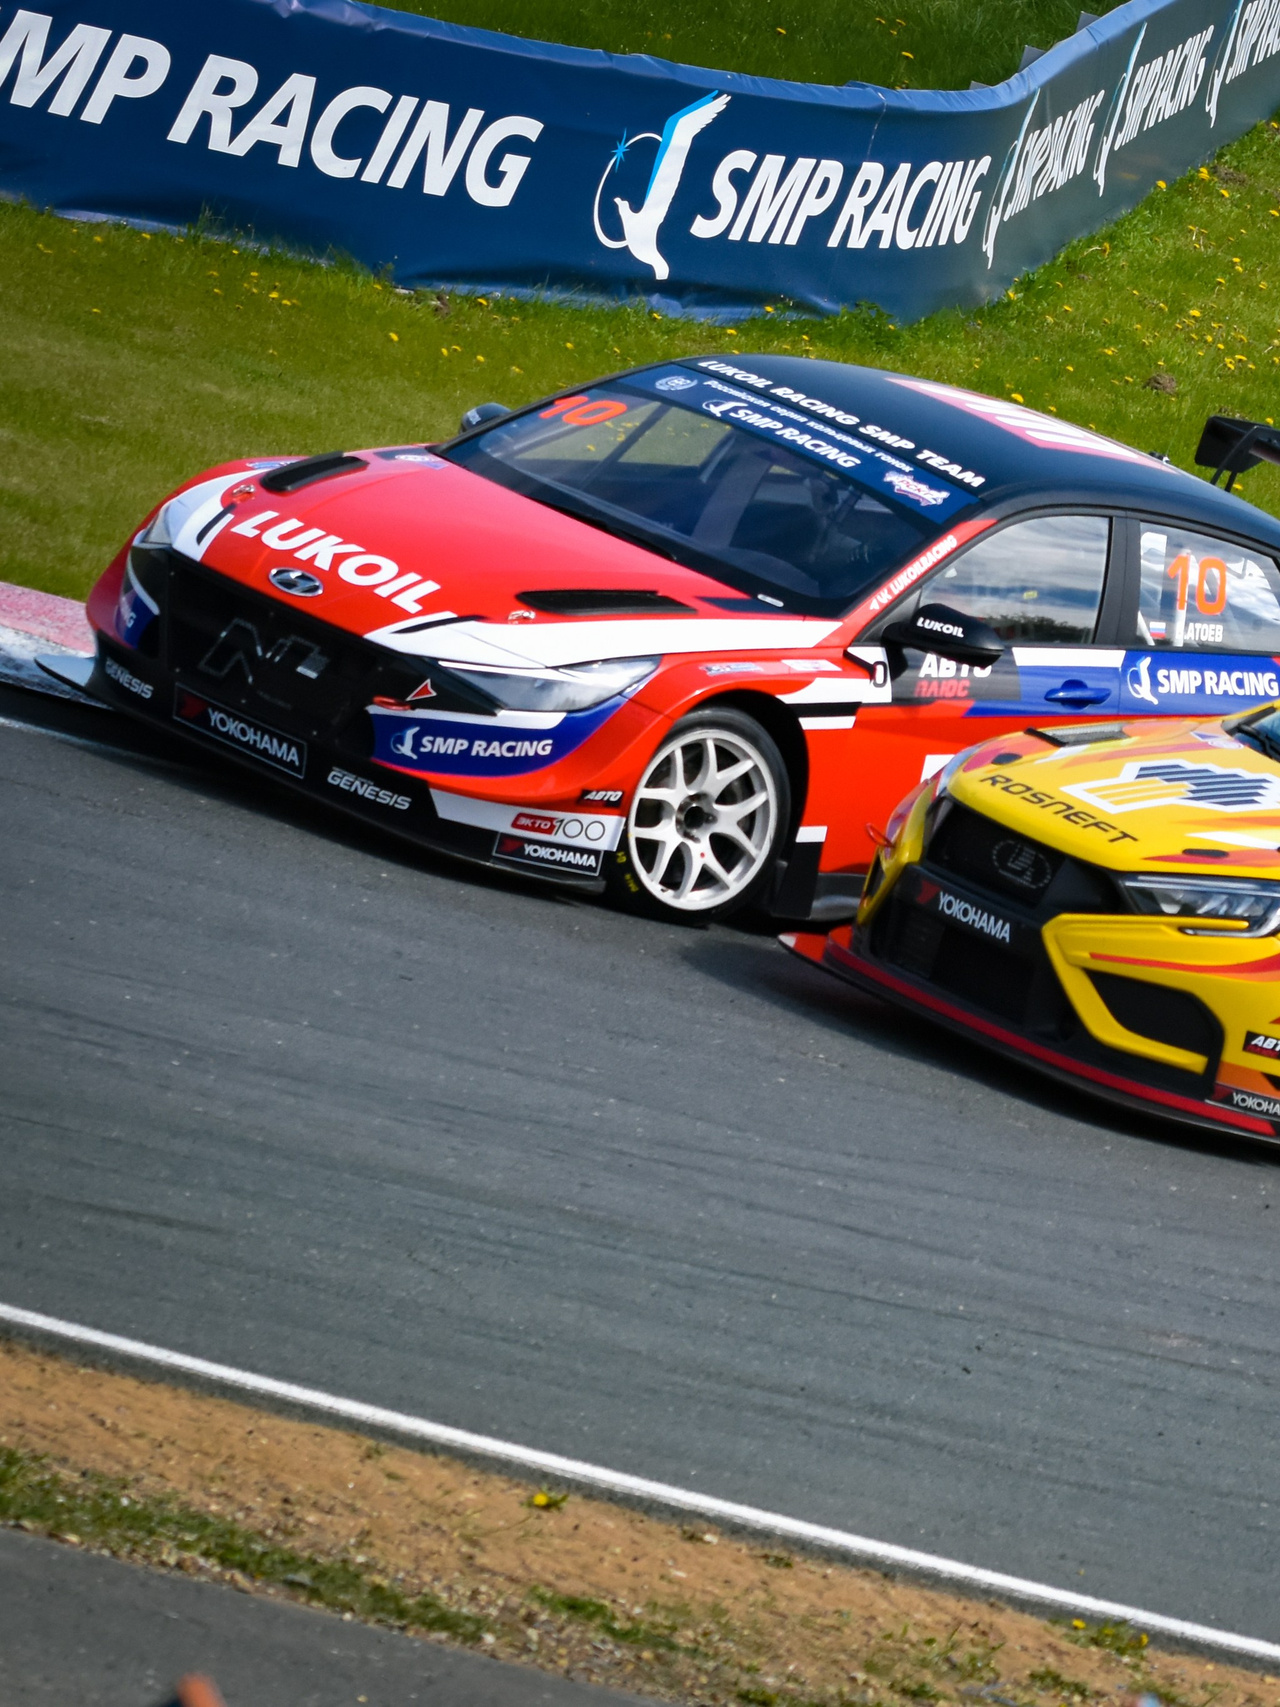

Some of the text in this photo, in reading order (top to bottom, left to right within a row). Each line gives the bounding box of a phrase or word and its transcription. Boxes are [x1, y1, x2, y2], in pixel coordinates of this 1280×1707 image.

[1114, 24, 1214, 151] SMP RACING
[166, 54, 544, 207] RACING
[690, 150, 992, 250] SMP RACING
[539, 395, 628, 426] 10
[698, 360, 985, 487] LUKOIL RACING SMP TEAM
[729, 409, 861, 468] SMP RACING
[230, 510, 441, 614] LUKOIL
[1167, 553, 1227, 615] 10
[916, 617, 964, 638] LUKOIL
[1176, 623, 1223, 642] .АТОЕВ
[105, 660, 154, 699] GENESIS
[1157, 669, 1279, 697] SMP RACING
[208, 707, 300, 766] YOKOHAMA
[419, 736, 553, 757] SMP RACING
[327, 771, 412, 810] GENESIS
[979, 774, 1139, 843] ROSNEFT
[553, 818, 606, 841] 100
[524, 844, 596, 868] YOKOHAMA
[938, 891, 1010, 943] YOKOHAMA
